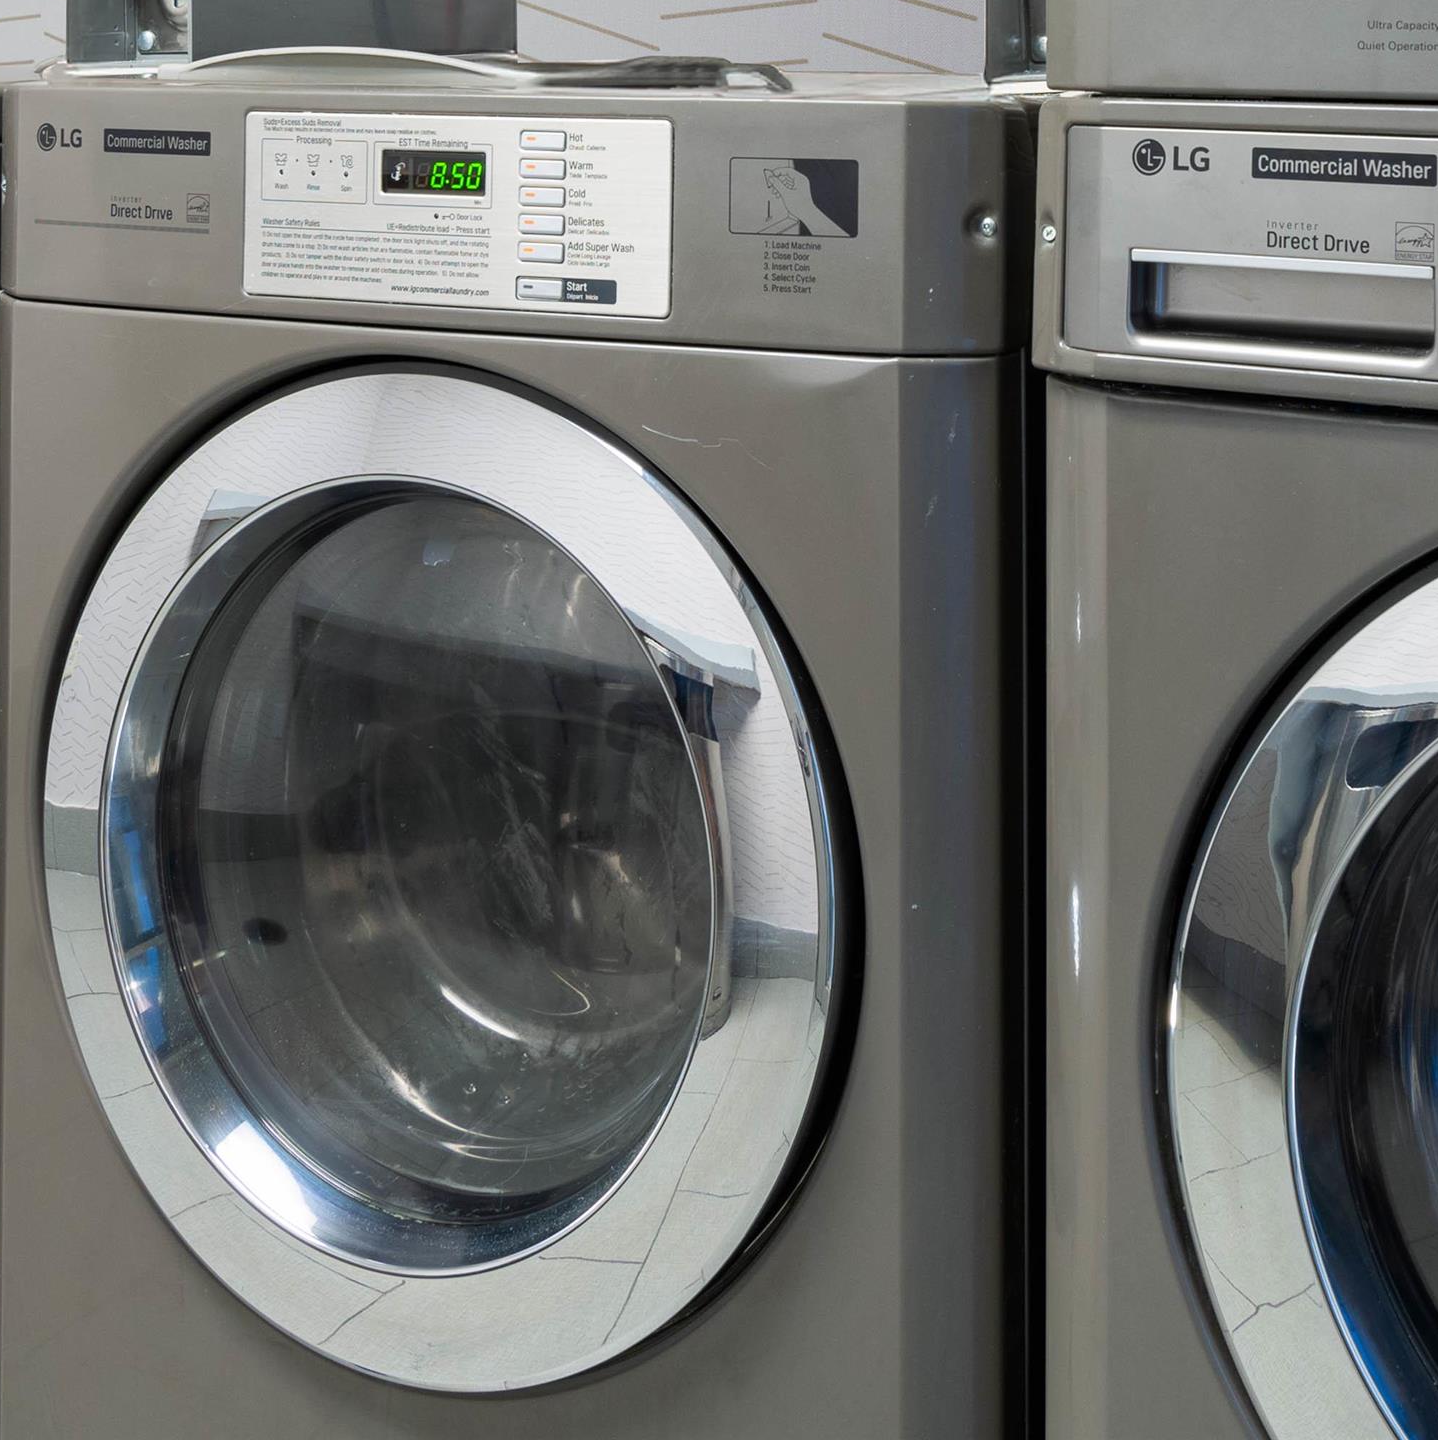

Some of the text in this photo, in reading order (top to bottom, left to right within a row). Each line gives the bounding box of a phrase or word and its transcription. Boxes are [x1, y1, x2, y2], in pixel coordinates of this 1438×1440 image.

[1367, 20, 1393, 31] Ultra
[1357, 40, 1385, 52] Quiet
[60, 128, 82, 148] LG
[107, 133, 208, 152] Commercial Washer
[296, 135, 332, 146] Processing
[569, 133, 583, 142] Hot
[432, 139, 469, 149] Remaining
[1173, 146, 1210, 172] LG
[569, 161, 594, 171] Warm
[1257, 154, 1432, 180] Commercial Washer
[430, 162, 482, 190] 8.50
[110, 195, 142, 203] Inverter
[568, 189, 586, 198] Cold
[110, 203, 141, 219] Direct
[145, 206, 173, 220] Drive
[568, 216, 605, 227] Delicates
[1266, 219, 1319, 231] Inverter
[436, 224, 449, 232] load
[456, 226, 474, 234] Press
[567, 242, 635, 254] Add Super Wash
[772, 241, 789, 249] Load
[791, 242, 822, 250] Machine
[1266, 232, 1370, 254] Direct Drive
[771, 252, 792, 260] Close
[793, 253, 810, 261] Door
[771, 263, 793, 271] Insert
[794, 264, 810, 272] Coin
[771, 273, 794, 282] Select
[795, 274, 816, 284] Cycle
[566, 281, 587, 292] Start
[771, 284, 792, 293] Press
[793, 285, 811, 294] Start
